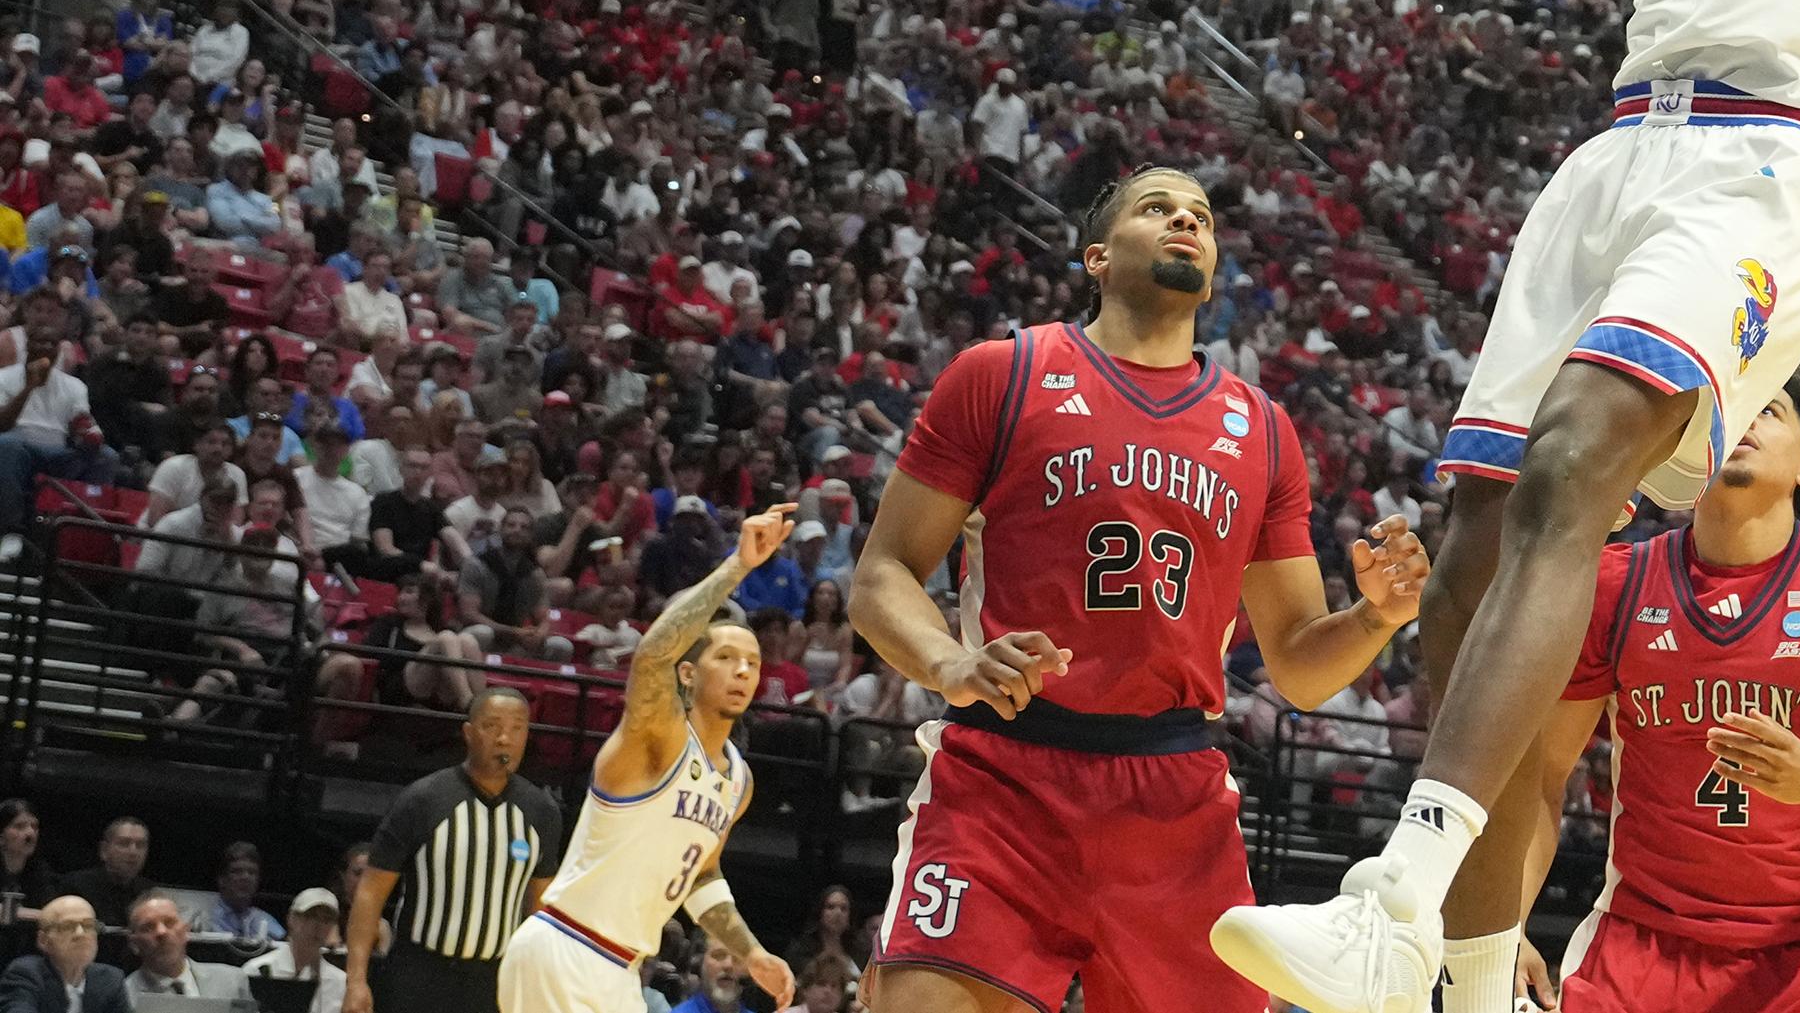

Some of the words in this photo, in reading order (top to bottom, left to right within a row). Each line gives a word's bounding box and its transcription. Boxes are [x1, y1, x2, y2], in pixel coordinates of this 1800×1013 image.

[1044, 446, 1098, 508] ST.
[1110, 444, 1240, 540] JOHN'S
[1084, 521, 1195, 620] 23
[1636, 615, 1669, 624] CHANGE
[1642, 607, 1655, 616] BE
[1655, 608, 1670, 617] THE
[1631, 684, 1672, 727] ST.
[1696, 754, 1749, 826] 4
[664, 843, 704, 902] 3
